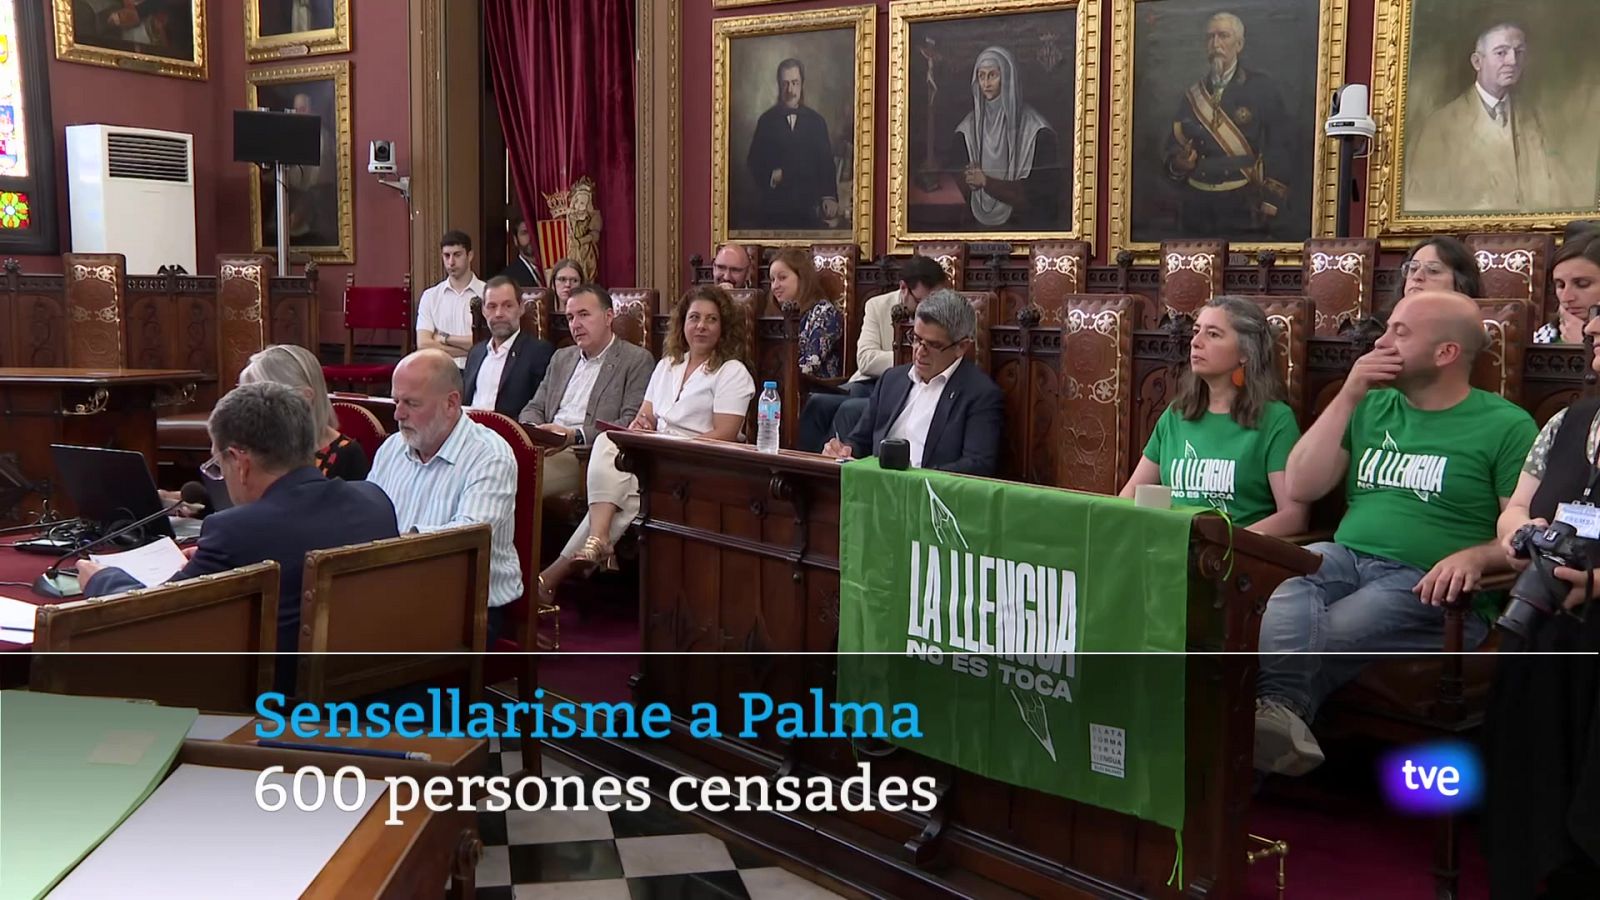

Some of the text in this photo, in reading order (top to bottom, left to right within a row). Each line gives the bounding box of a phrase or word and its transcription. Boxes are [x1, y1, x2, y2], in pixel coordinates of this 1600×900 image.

[1170, 458, 1236, 493] LA LLENGUA
[1358, 448, 1448, 493] LA LLENGUA
[1171, 490, 1185, 498] NO
[1202, 492, 1234, 500] TOCA
[908, 540, 1077, 678] LA LLENGUA
[906, 639, 1074, 703] NO ES TOCA
